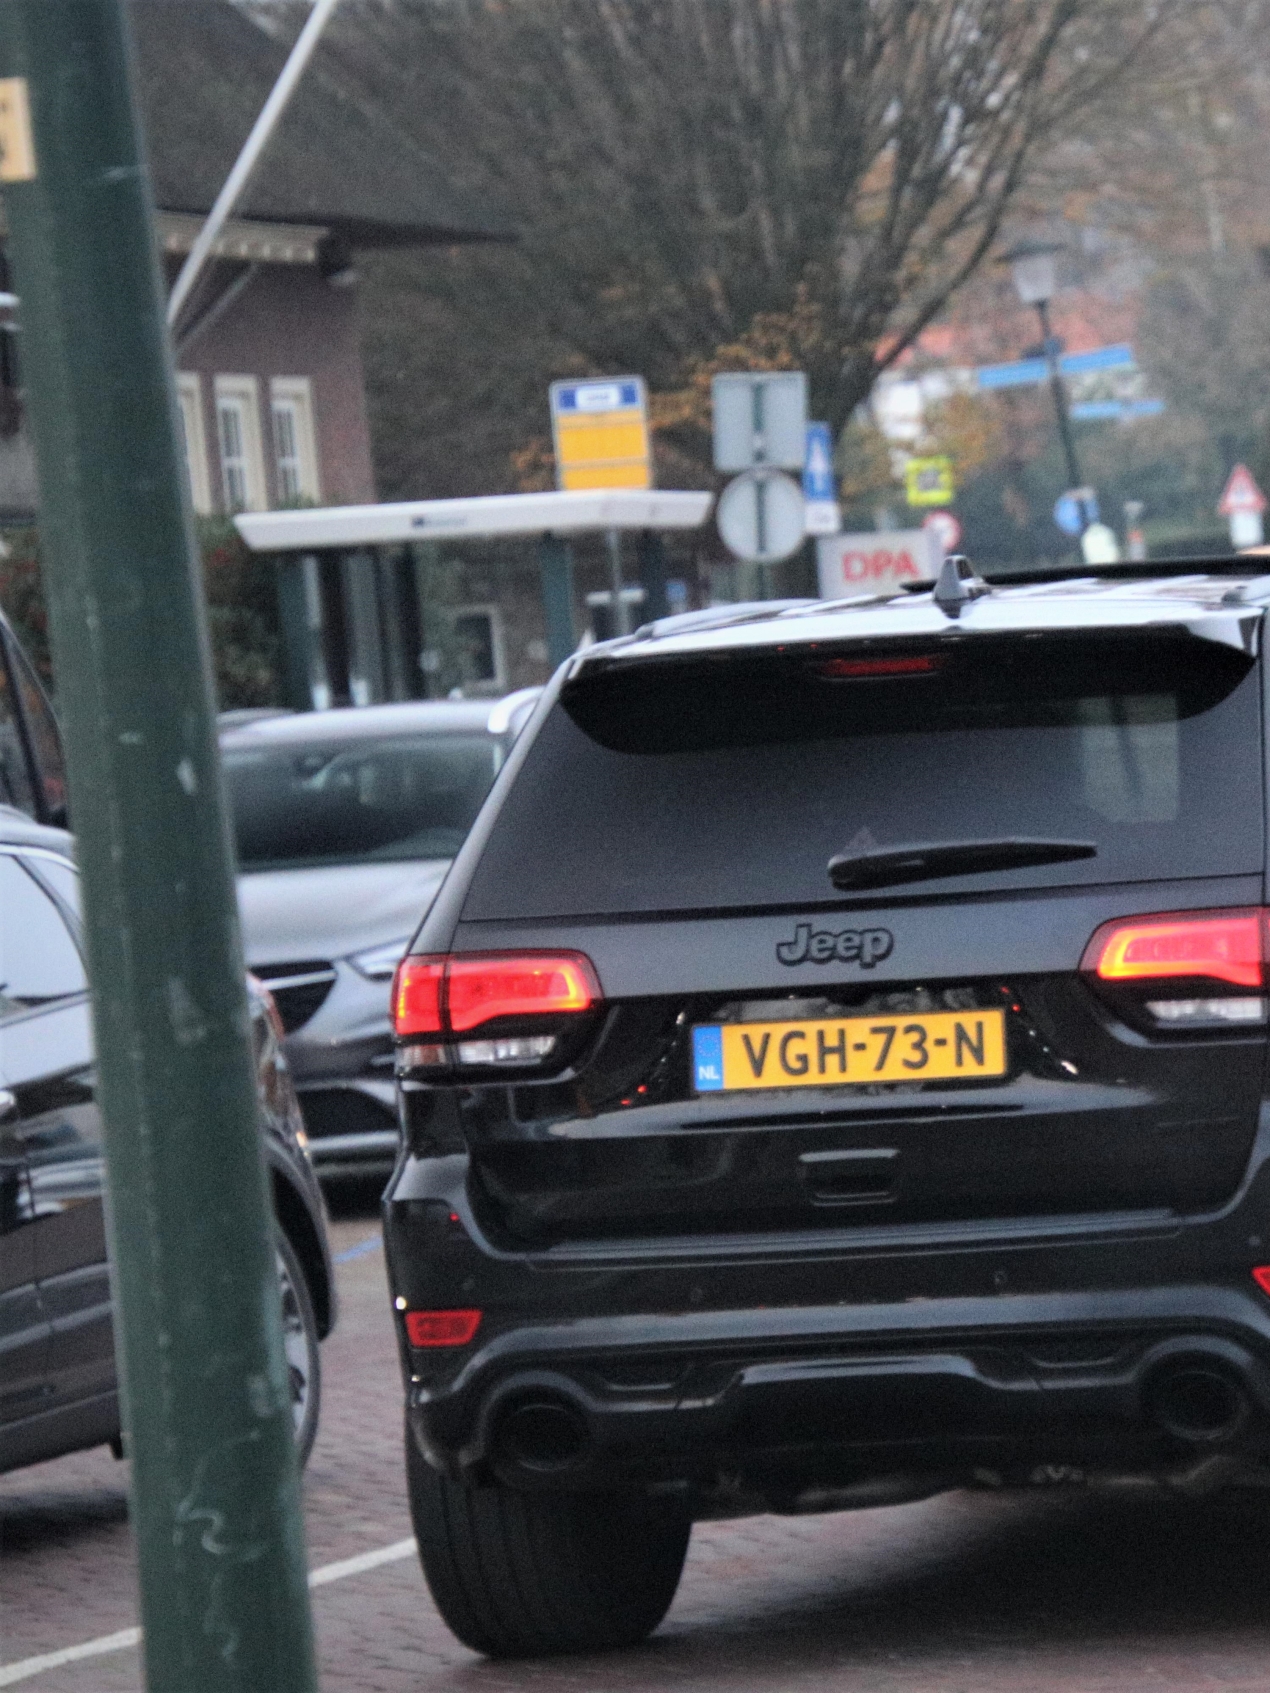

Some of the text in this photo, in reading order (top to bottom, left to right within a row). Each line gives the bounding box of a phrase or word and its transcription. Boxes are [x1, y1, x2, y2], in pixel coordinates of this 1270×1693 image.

[842, 549, 919, 582] DPA
[776, 923, 894, 969] Jeep
[741, 1020, 986, 1078] VGH-73-N
[699, 1065, 719, 1080] NL
